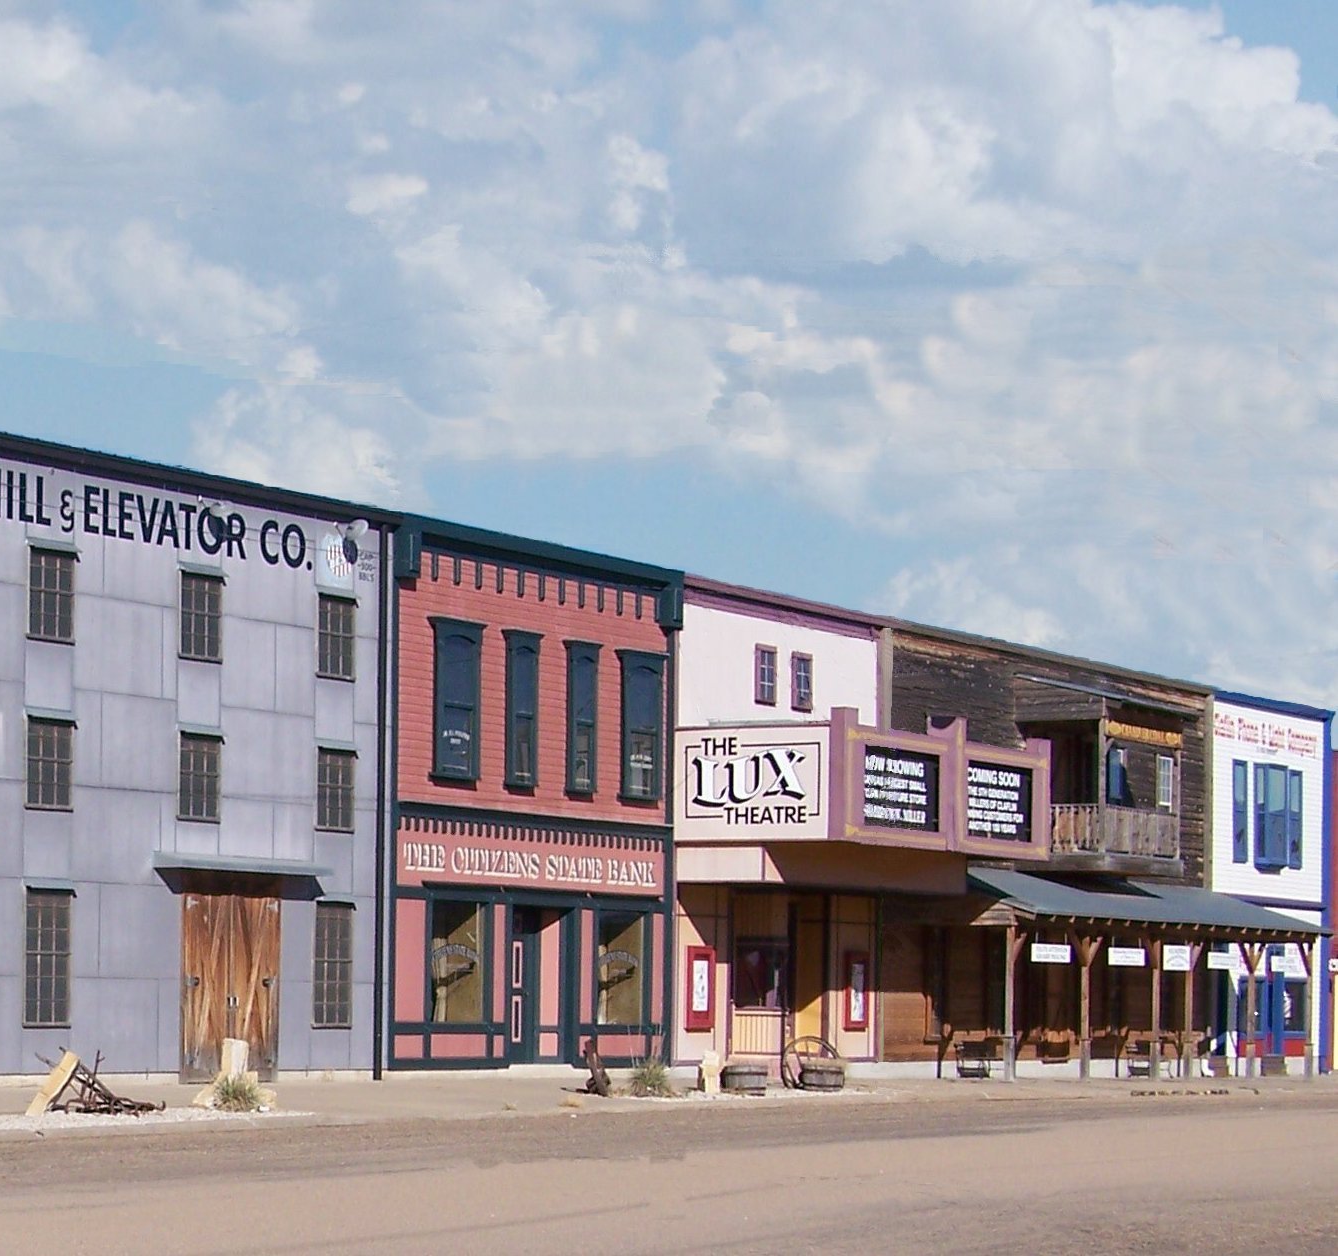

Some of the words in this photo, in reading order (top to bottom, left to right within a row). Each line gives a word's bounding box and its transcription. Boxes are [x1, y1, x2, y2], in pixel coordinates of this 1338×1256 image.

[60, 489, 74, 533] &
[83, 485, 247, 560] ELEVATOR
[260, 519, 313, 571] CO.
[701, 737, 738, 756] THE
[691, 747, 806, 808] LUX
[968, 767, 998, 785] COMING
[998, 771, 1021, 788] SOON
[724, 806, 807, 825] THEATRE
[404, 842, 446, 873] THE
[451, 846, 540, 880] CITIZENS
[546, 853, 604, 884] STATE
[606, 859, 658, 888] BANK
